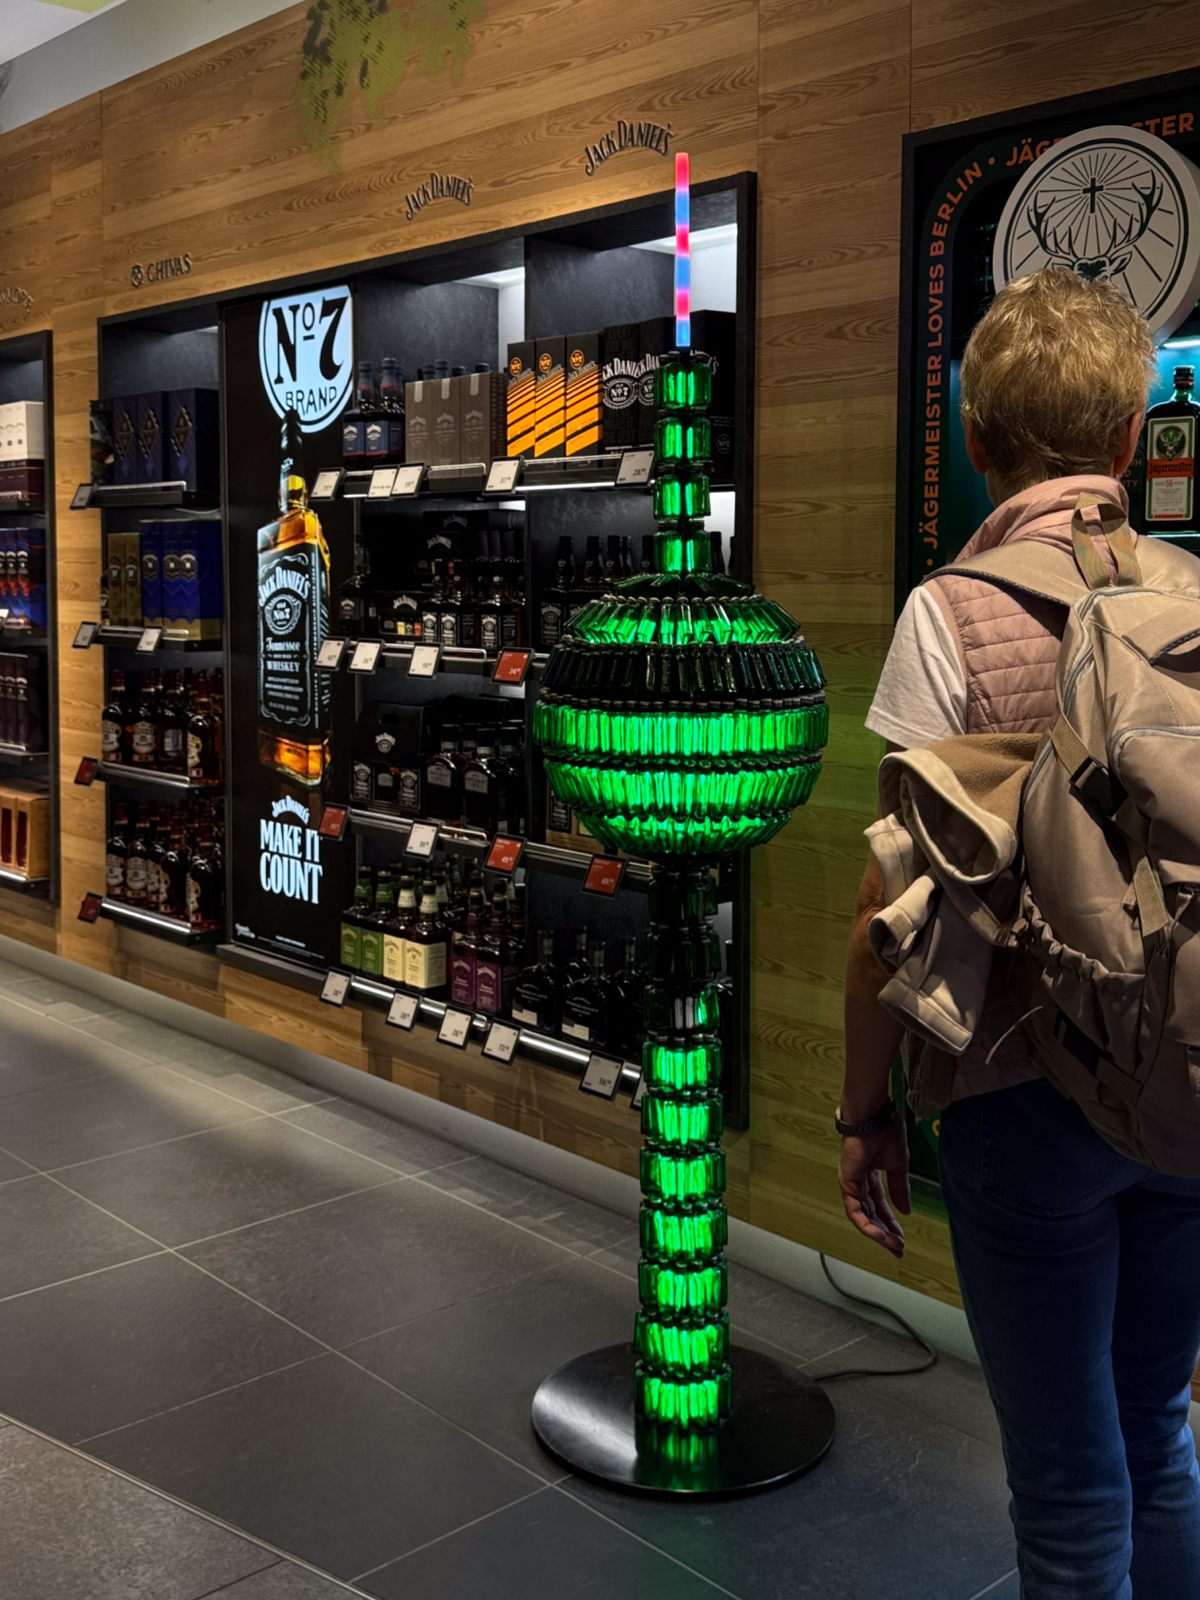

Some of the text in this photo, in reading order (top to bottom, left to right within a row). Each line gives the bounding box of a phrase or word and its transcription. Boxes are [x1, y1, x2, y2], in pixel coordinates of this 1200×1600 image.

[584, 119, 674, 176] JACK DANIEL'S
[405, 172, 475, 221] JACK DANIEL'S
[147, 253, 192, 283] CHIVAS
[917, 160, 984, 551] JÄGERMEISTER LOVES BERLIN
[285, 386, 338, 416] BRAND
[265, 660, 301, 673] WHISKEY
[259, 818, 323, 863] MAKE IT
[259, 851, 324, 905] COUNT
